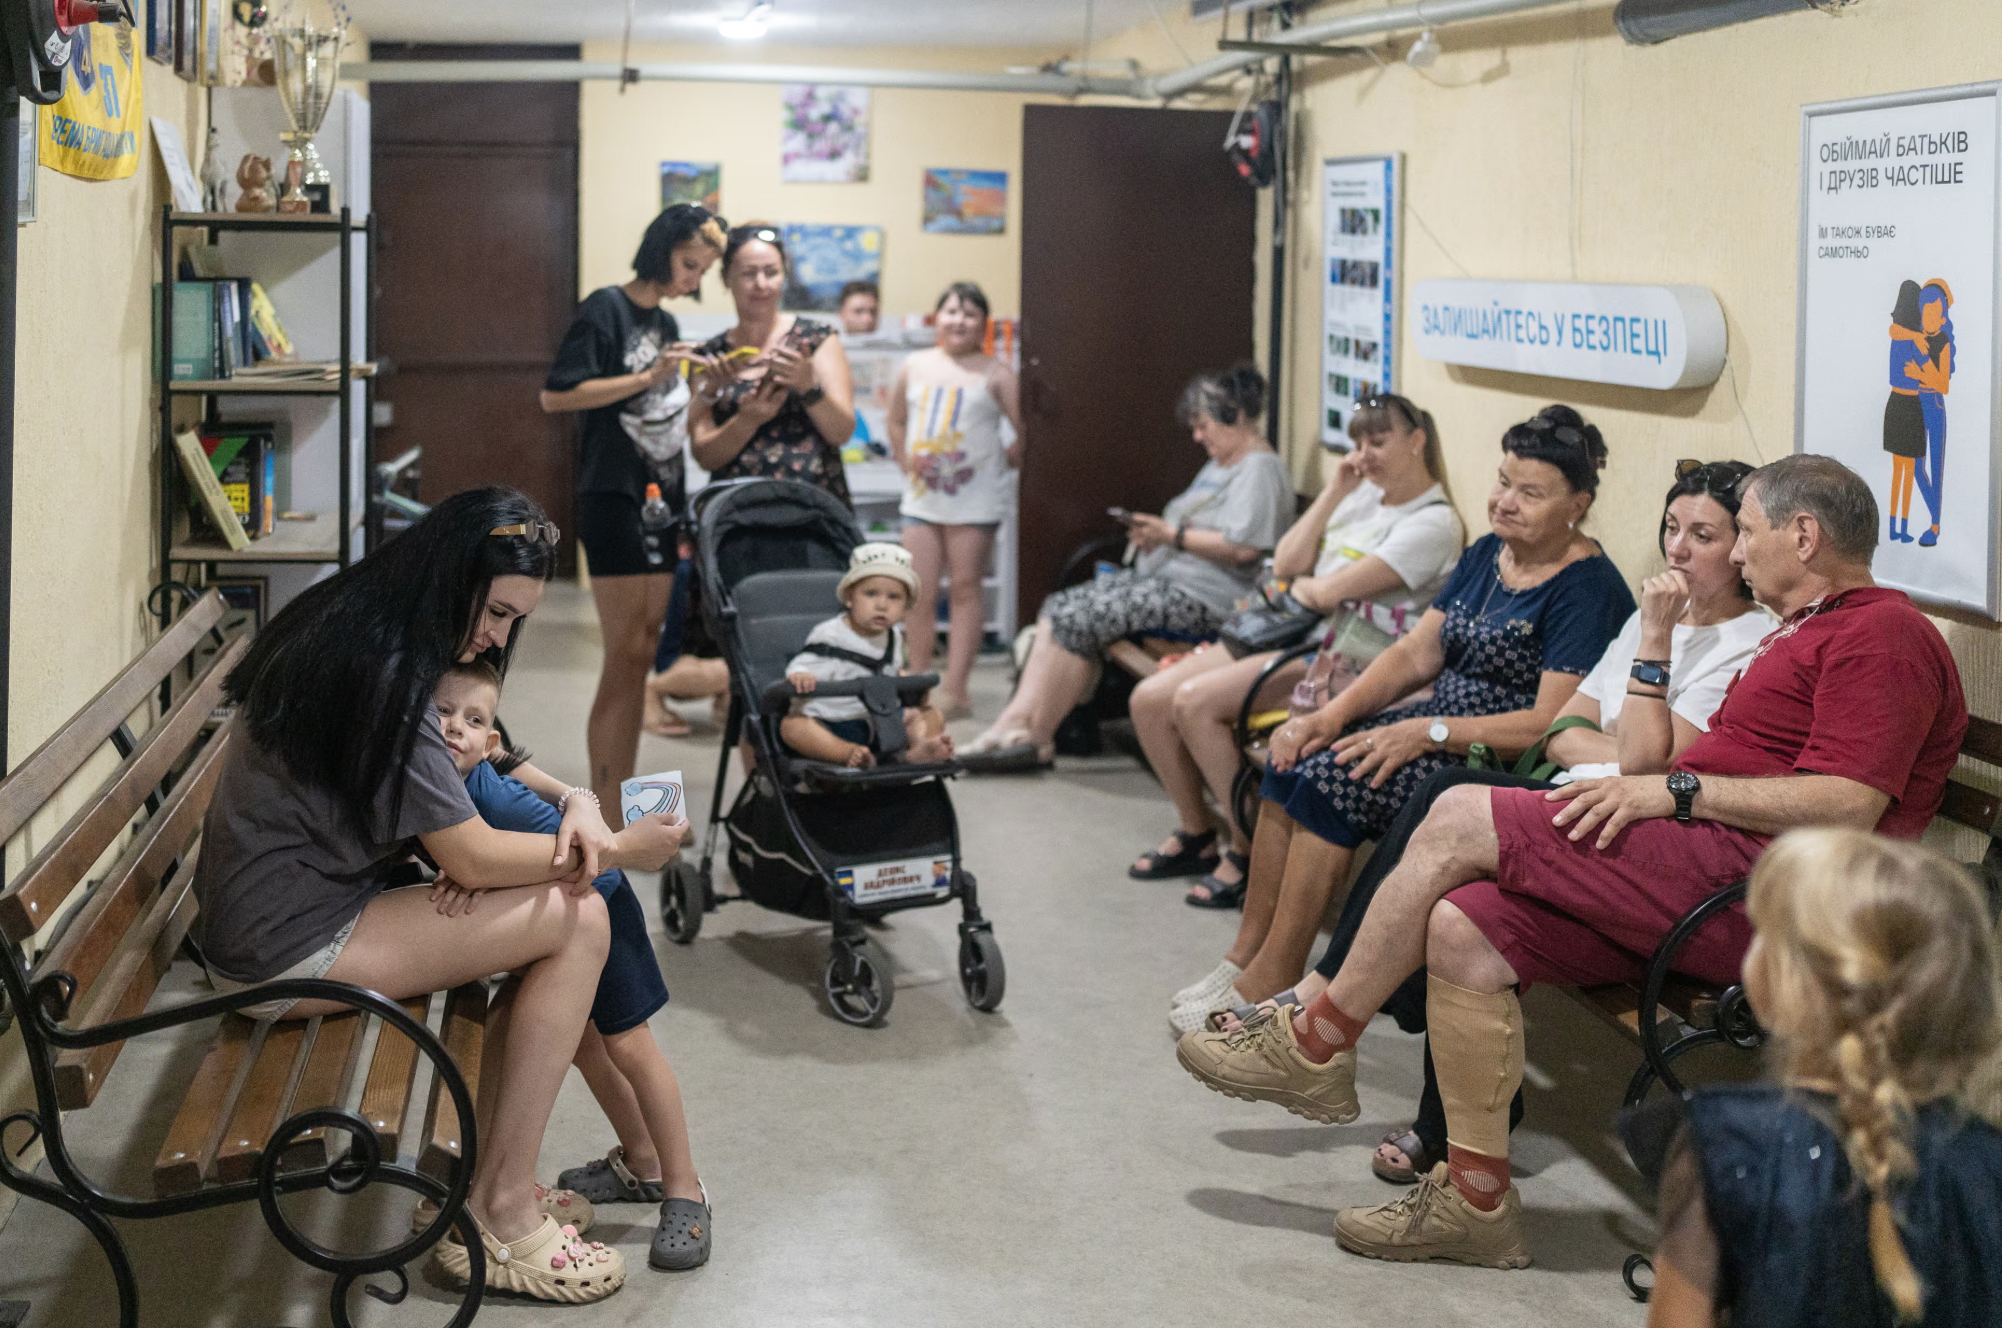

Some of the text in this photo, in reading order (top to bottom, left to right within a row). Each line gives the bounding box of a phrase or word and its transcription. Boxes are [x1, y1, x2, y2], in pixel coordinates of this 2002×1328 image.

[1819, 130, 1969, 163] ОБІЙМАЙ БАТЬКІВ
[1827, 168, 1879, 195] ДРУЗІВ
[1885, 162, 1964, 187] ЧАСТІШЕ
[1818, 224, 1896, 239] ЇМ ТАКОЖ БУВАЄ
[1818, 245, 1869, 259] САМОТНЬО
[1422, 300, 1667, 365] ЗАЛИШАЙТЕСЬ У БЕЗПЕЦІ
